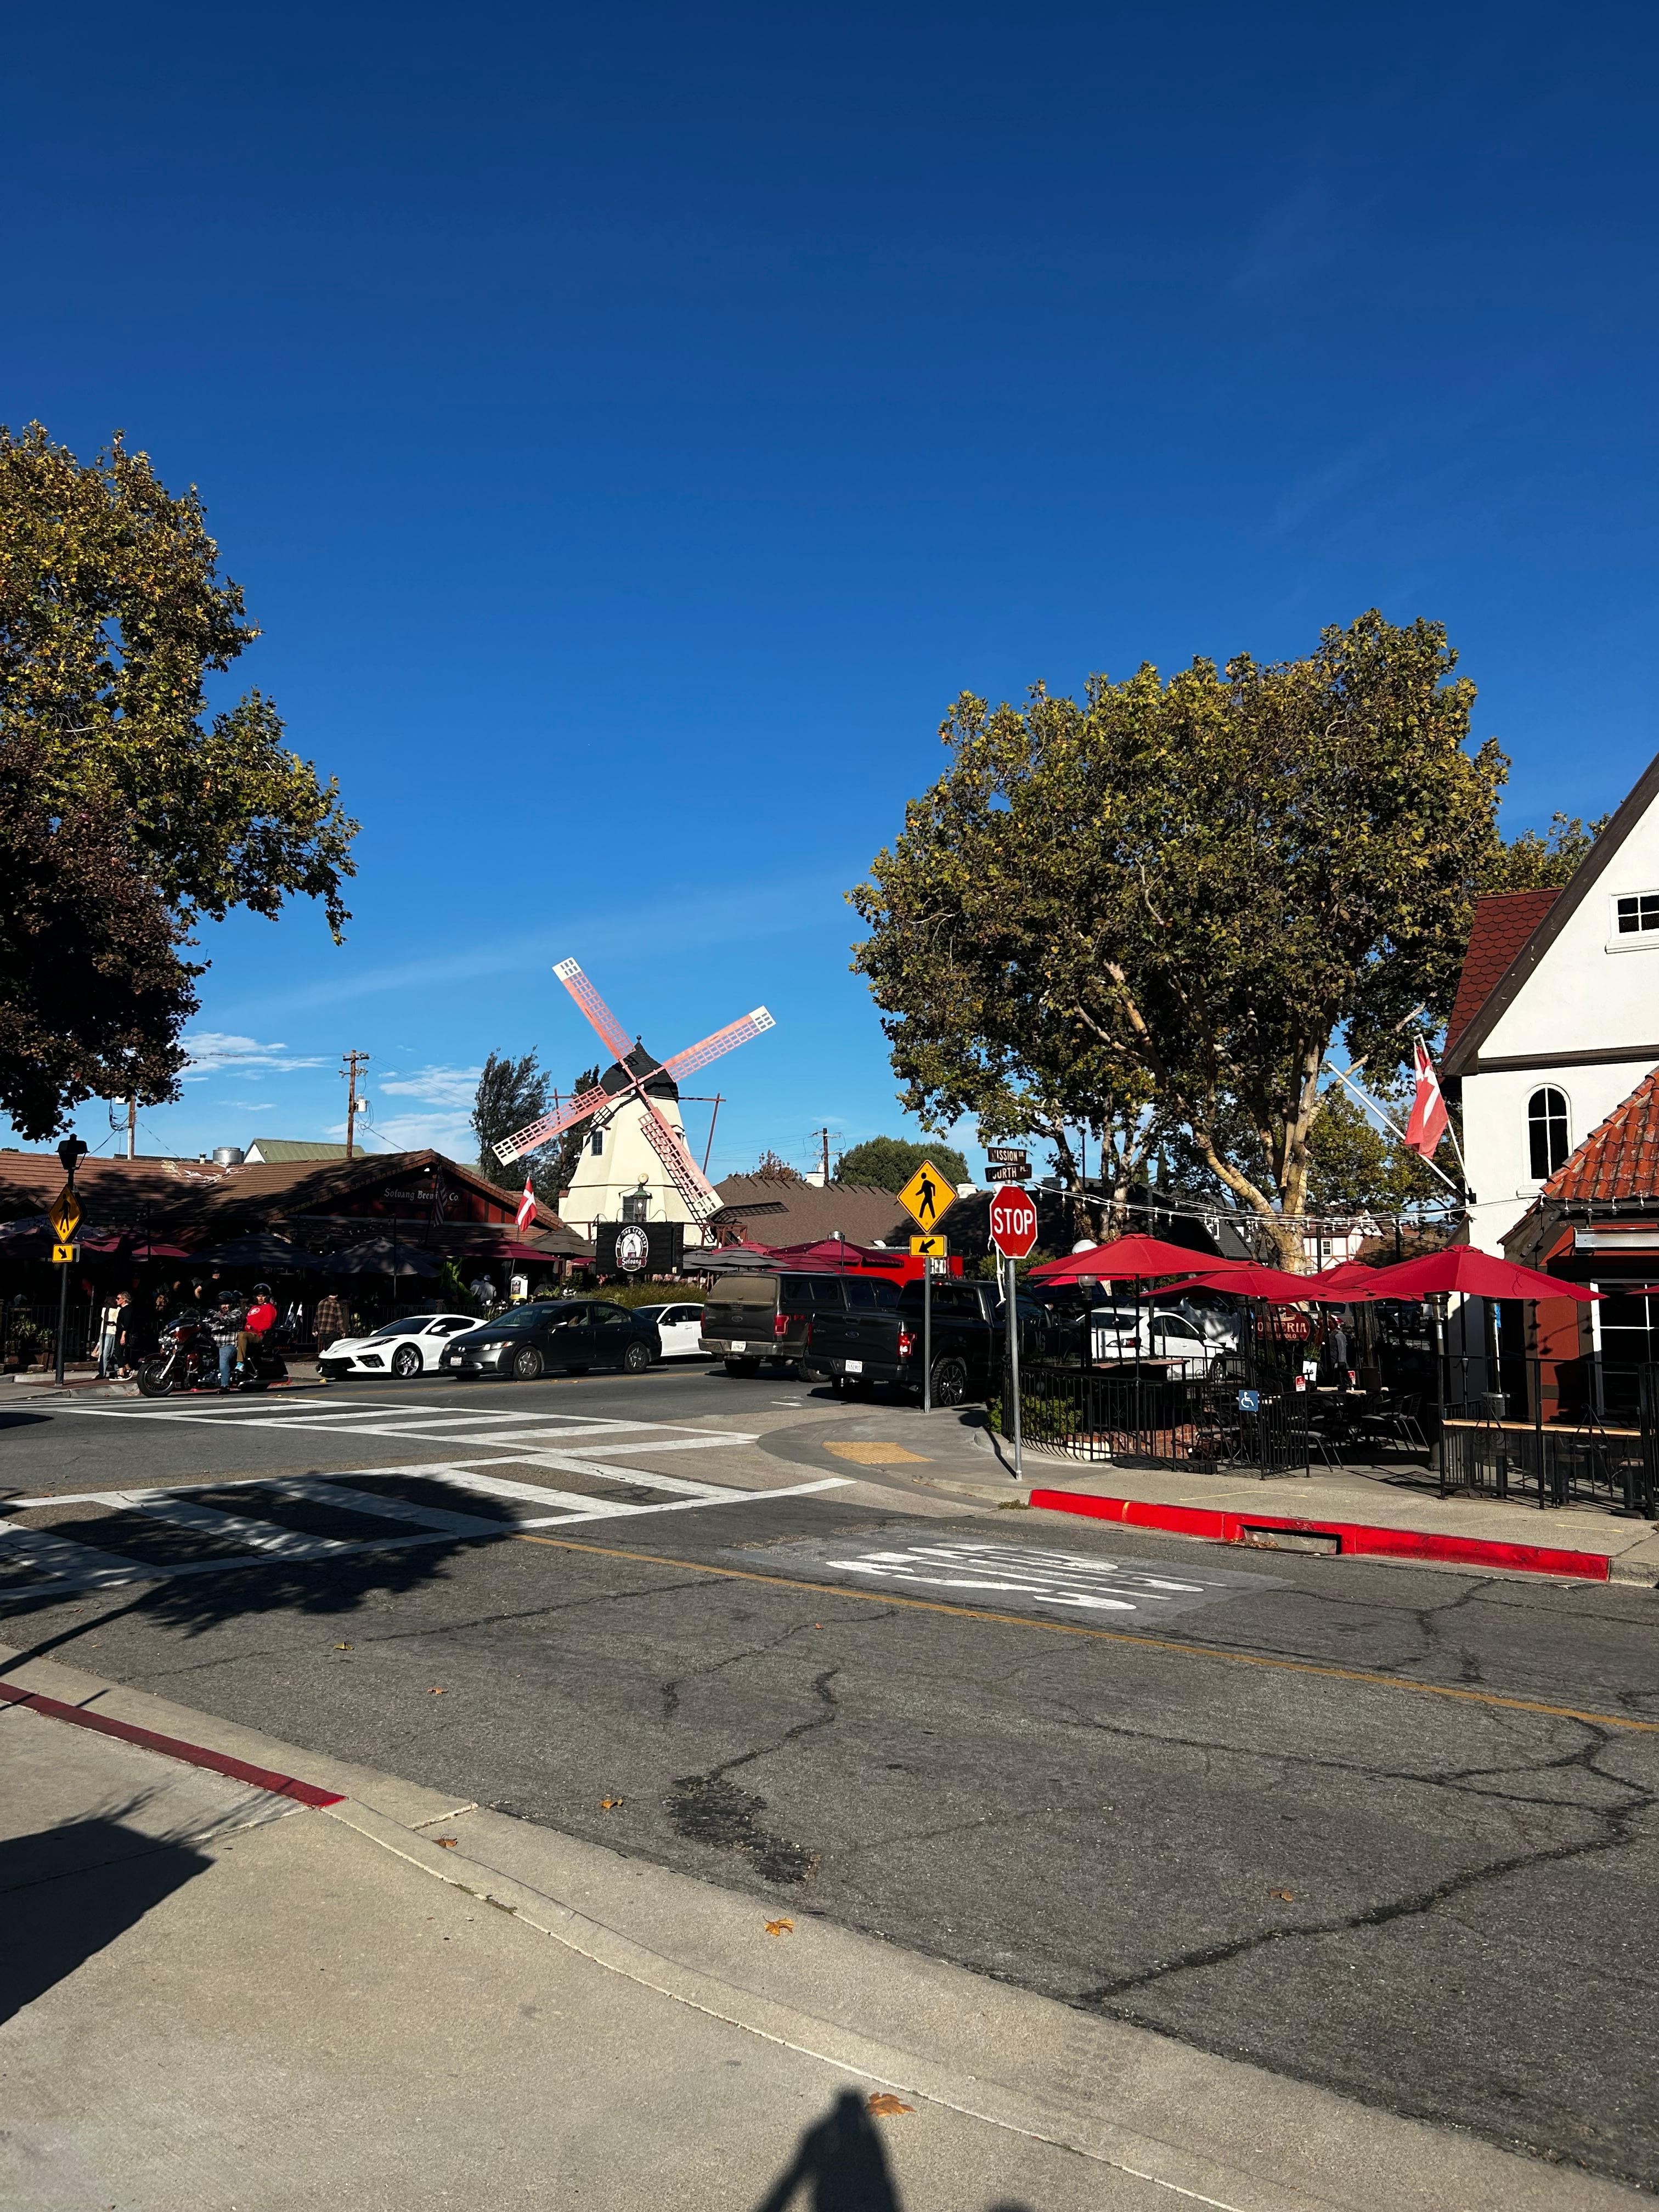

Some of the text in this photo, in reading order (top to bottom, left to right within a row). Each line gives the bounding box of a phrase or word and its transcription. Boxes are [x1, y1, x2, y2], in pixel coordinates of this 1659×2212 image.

[988, 1166, 1017, 1180] FOURTH
[384, 1188, 415, 1201] Solvang
[994, 1207, 1033, 1235] STOP
[622, 1257, 642, 1266] Solvang
[825, 1542, 1228, 1611] STOP
